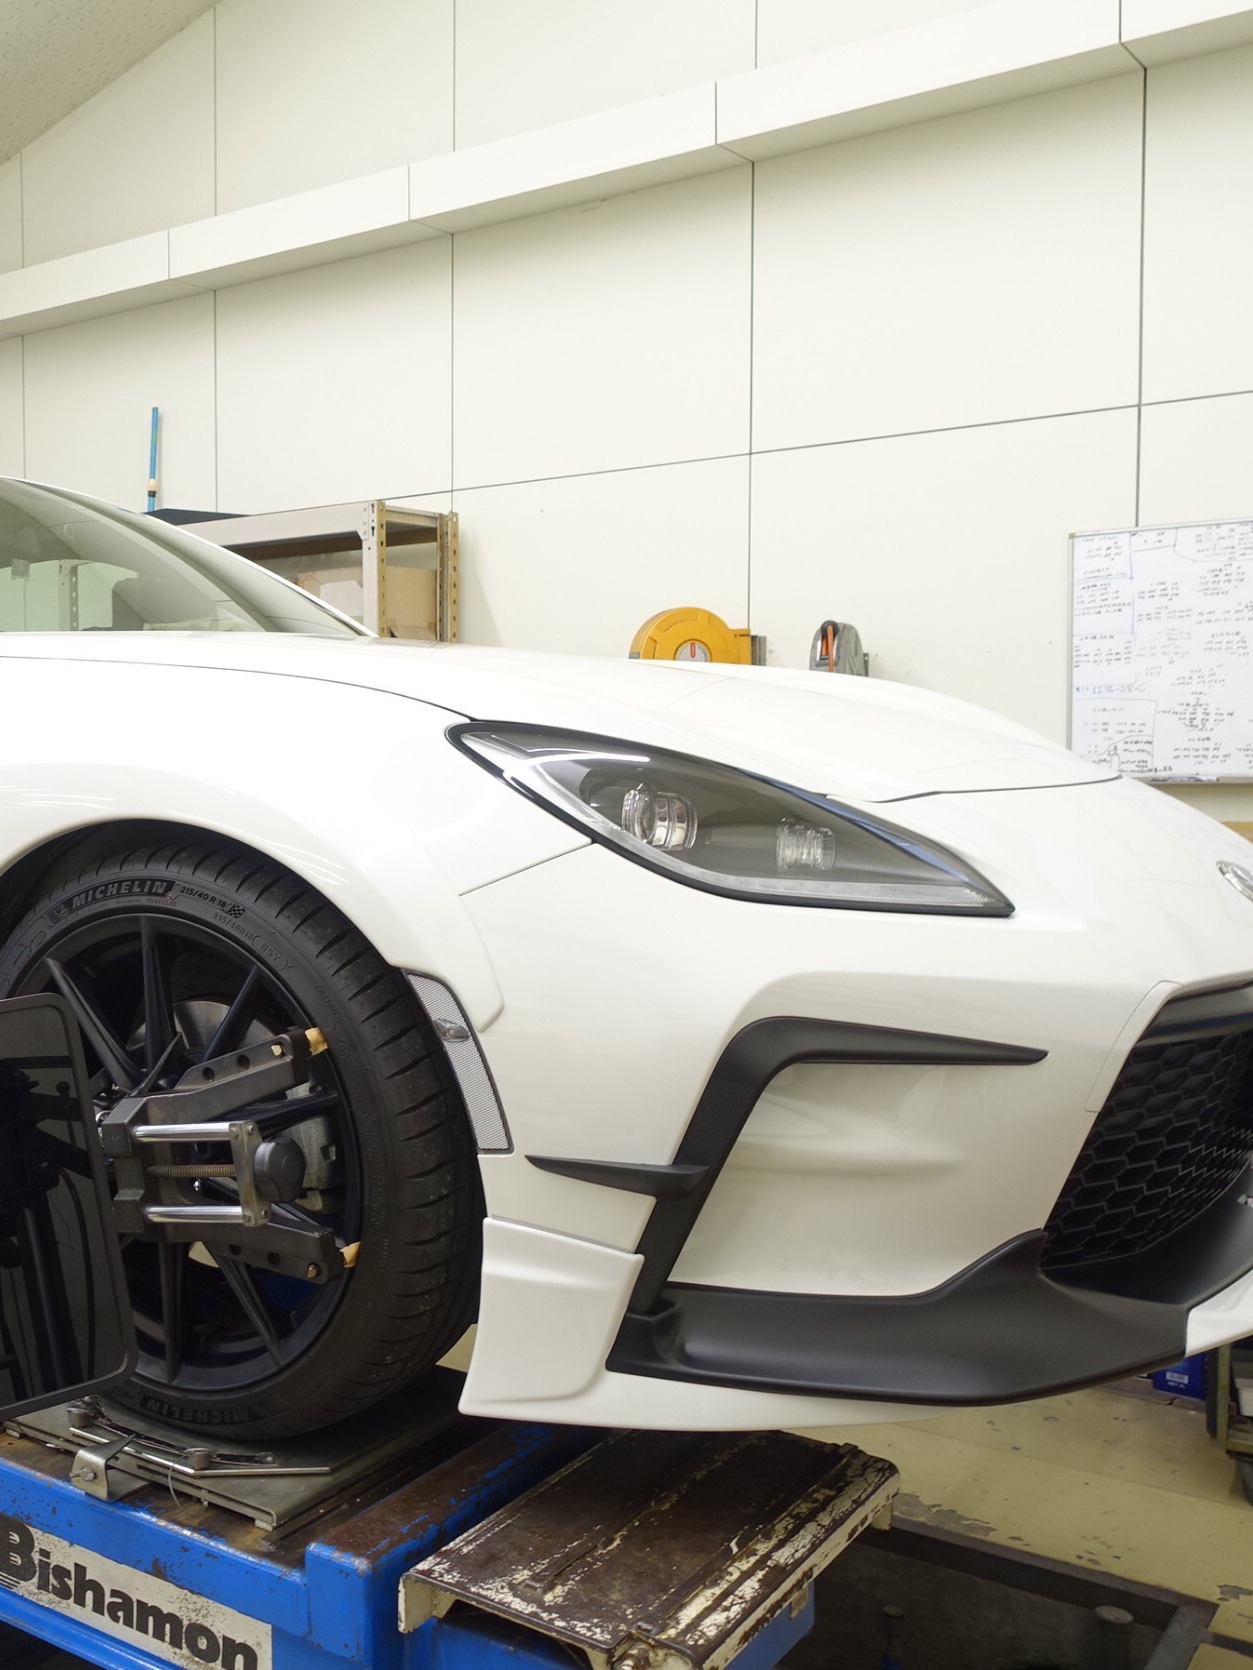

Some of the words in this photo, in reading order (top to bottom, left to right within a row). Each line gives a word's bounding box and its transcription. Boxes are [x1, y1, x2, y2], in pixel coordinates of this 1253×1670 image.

[72, 880, 168, 909] MICHELIN
[179, 886, 209, 901] 215/40
[217, 900, 227, 908] 18
[146, 1398, 250, 1423] MICHELIN
